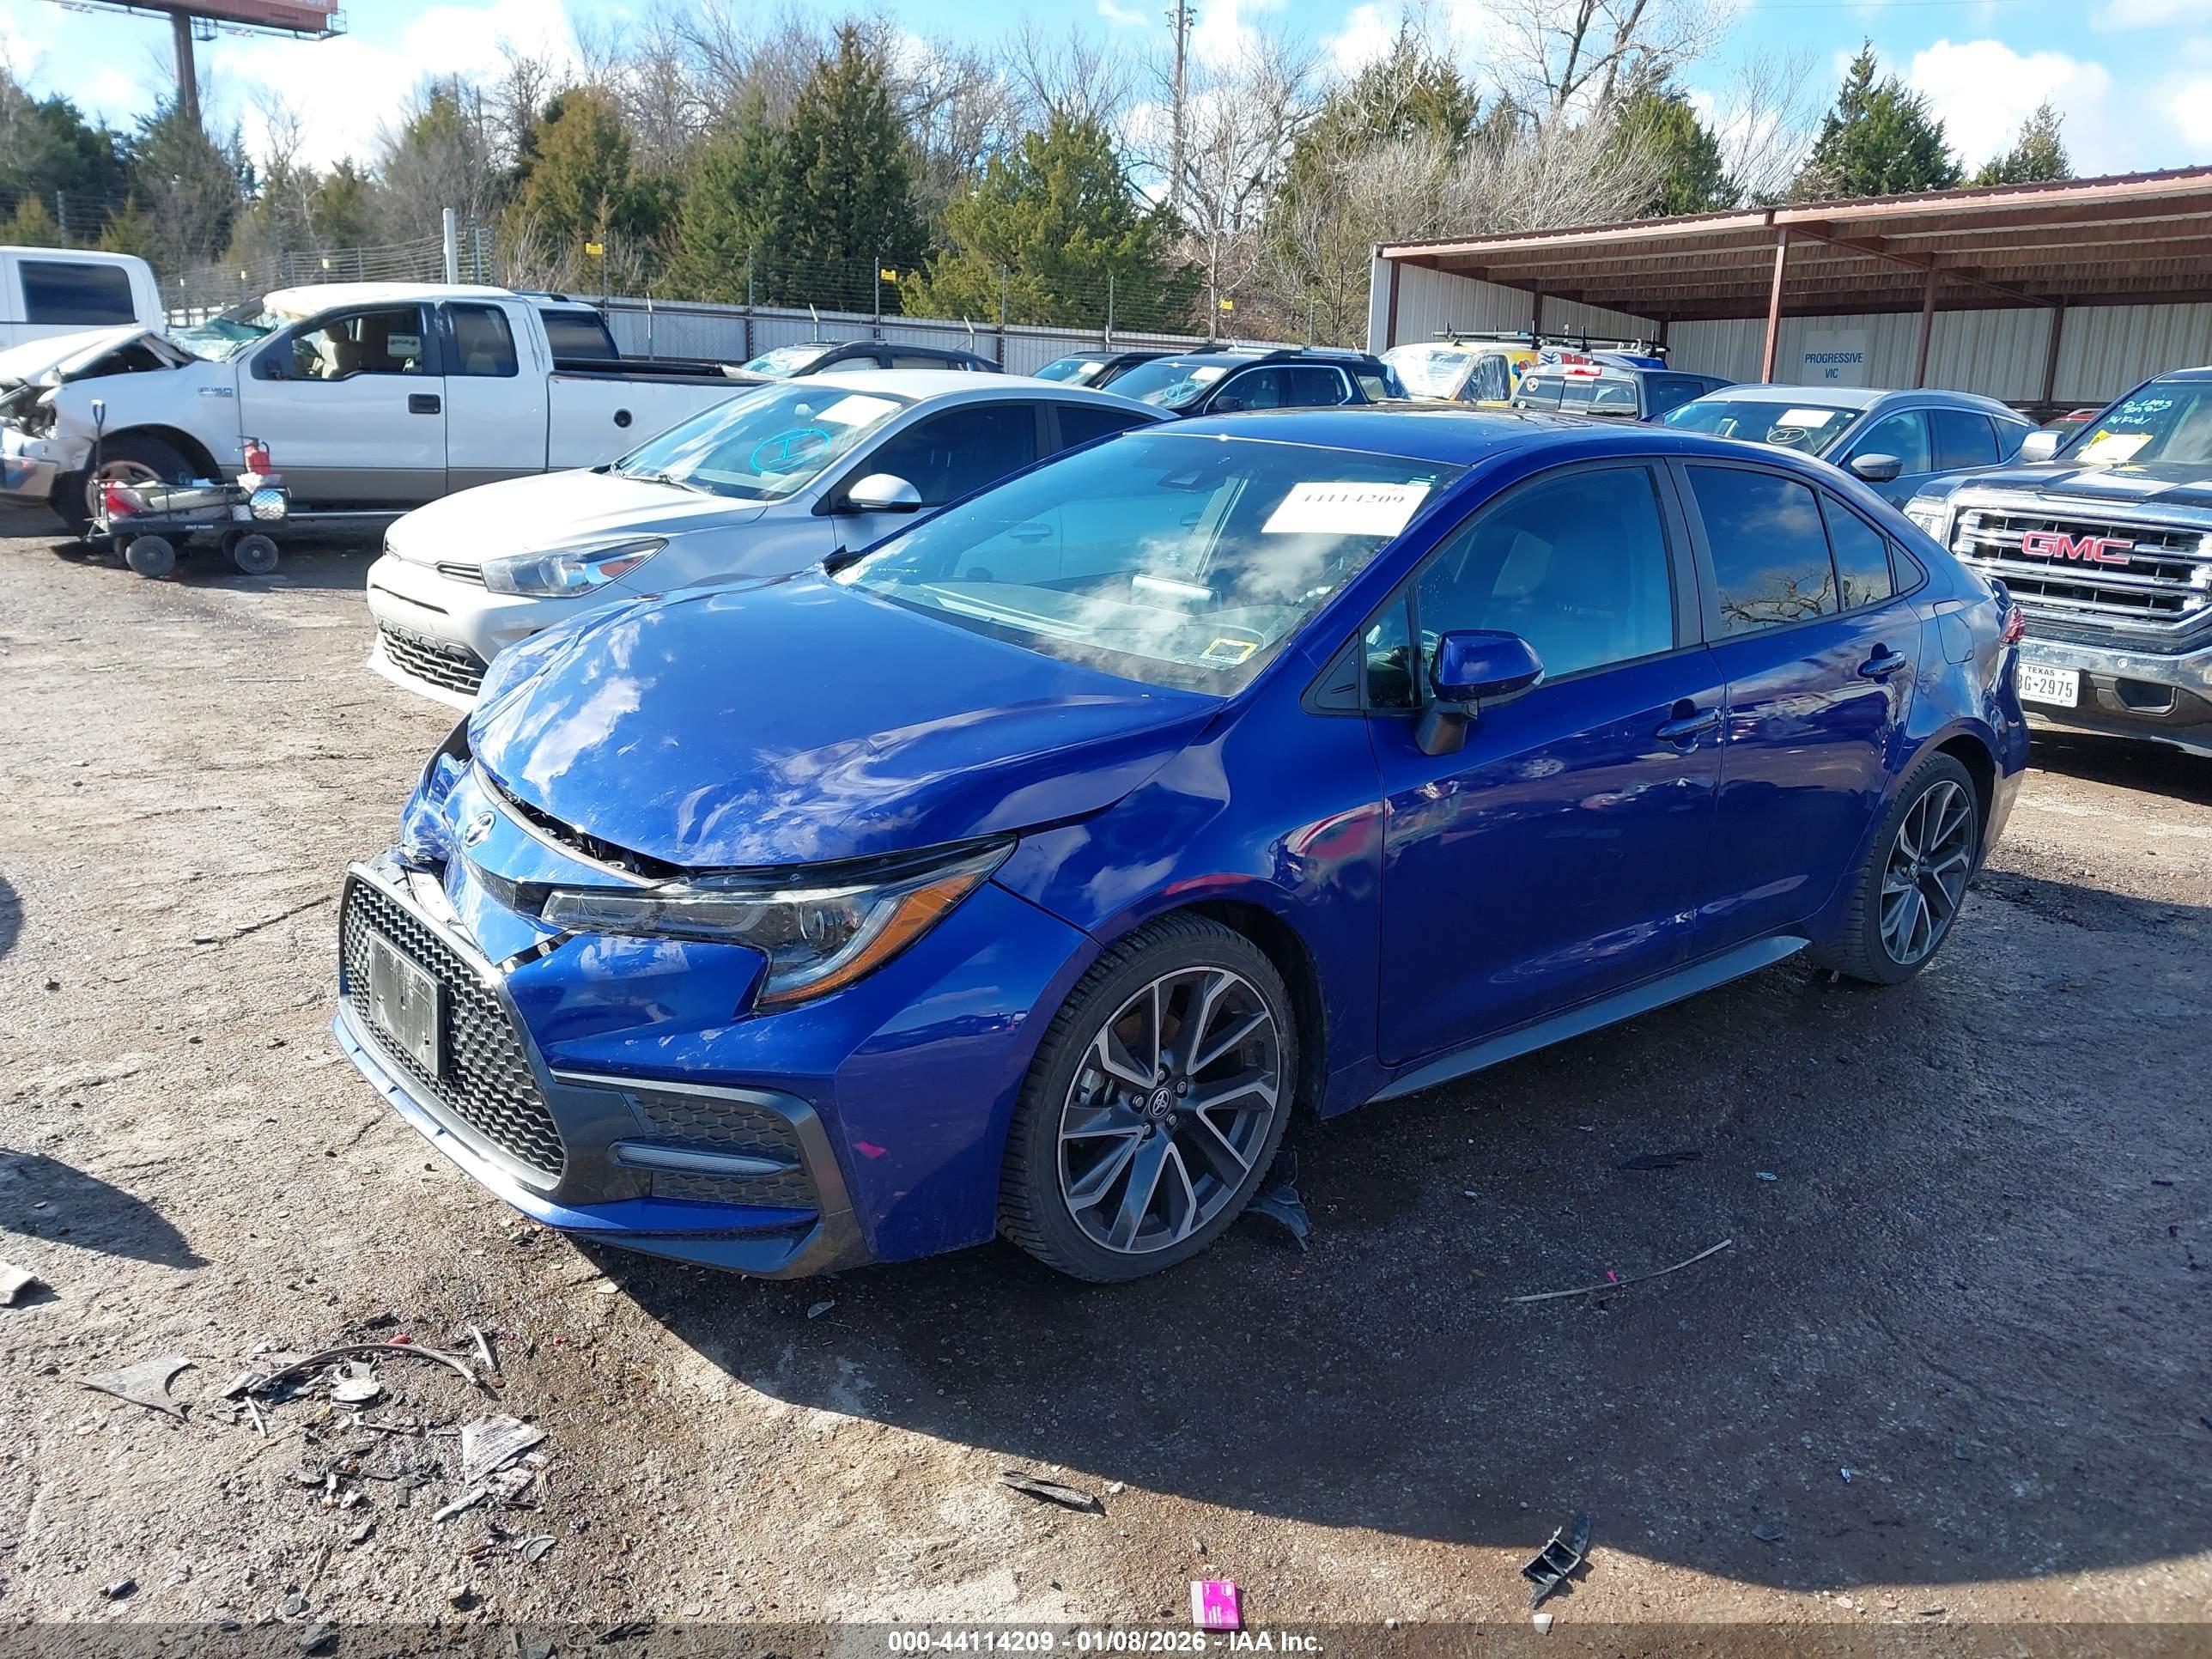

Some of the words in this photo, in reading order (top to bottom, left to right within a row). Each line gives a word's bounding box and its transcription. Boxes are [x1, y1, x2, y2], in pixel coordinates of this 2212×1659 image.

[1805, 352, 1863, 364] PROGRESSIVE
[1825, 368, 1838, 379] VIC
[2021, 530, 2134, 566] GMC
[2027, 665, 2056, 678] TEXAS
